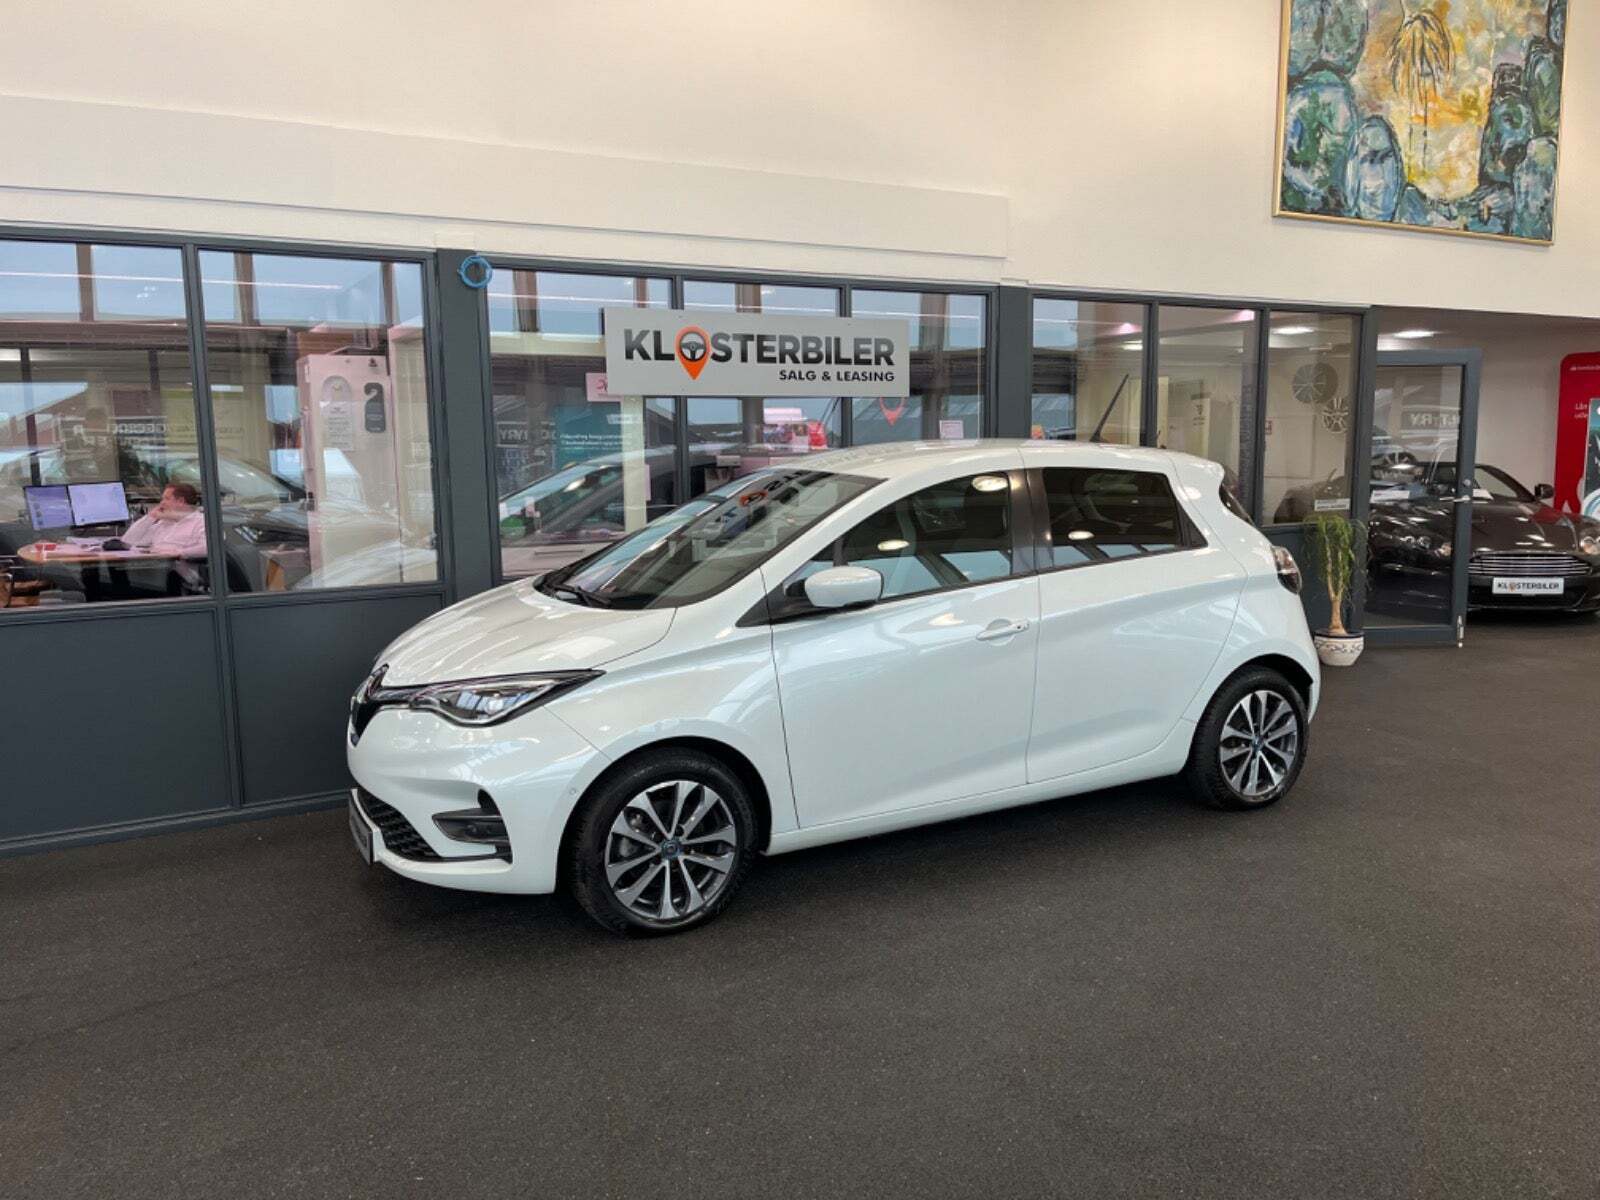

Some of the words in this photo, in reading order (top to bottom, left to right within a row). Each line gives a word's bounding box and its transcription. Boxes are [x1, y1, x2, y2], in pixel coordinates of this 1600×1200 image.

[779, 370, 817, 383] SALG
[821, 371, 831, 383] &
[836, 370, 896, 384] LEASING
